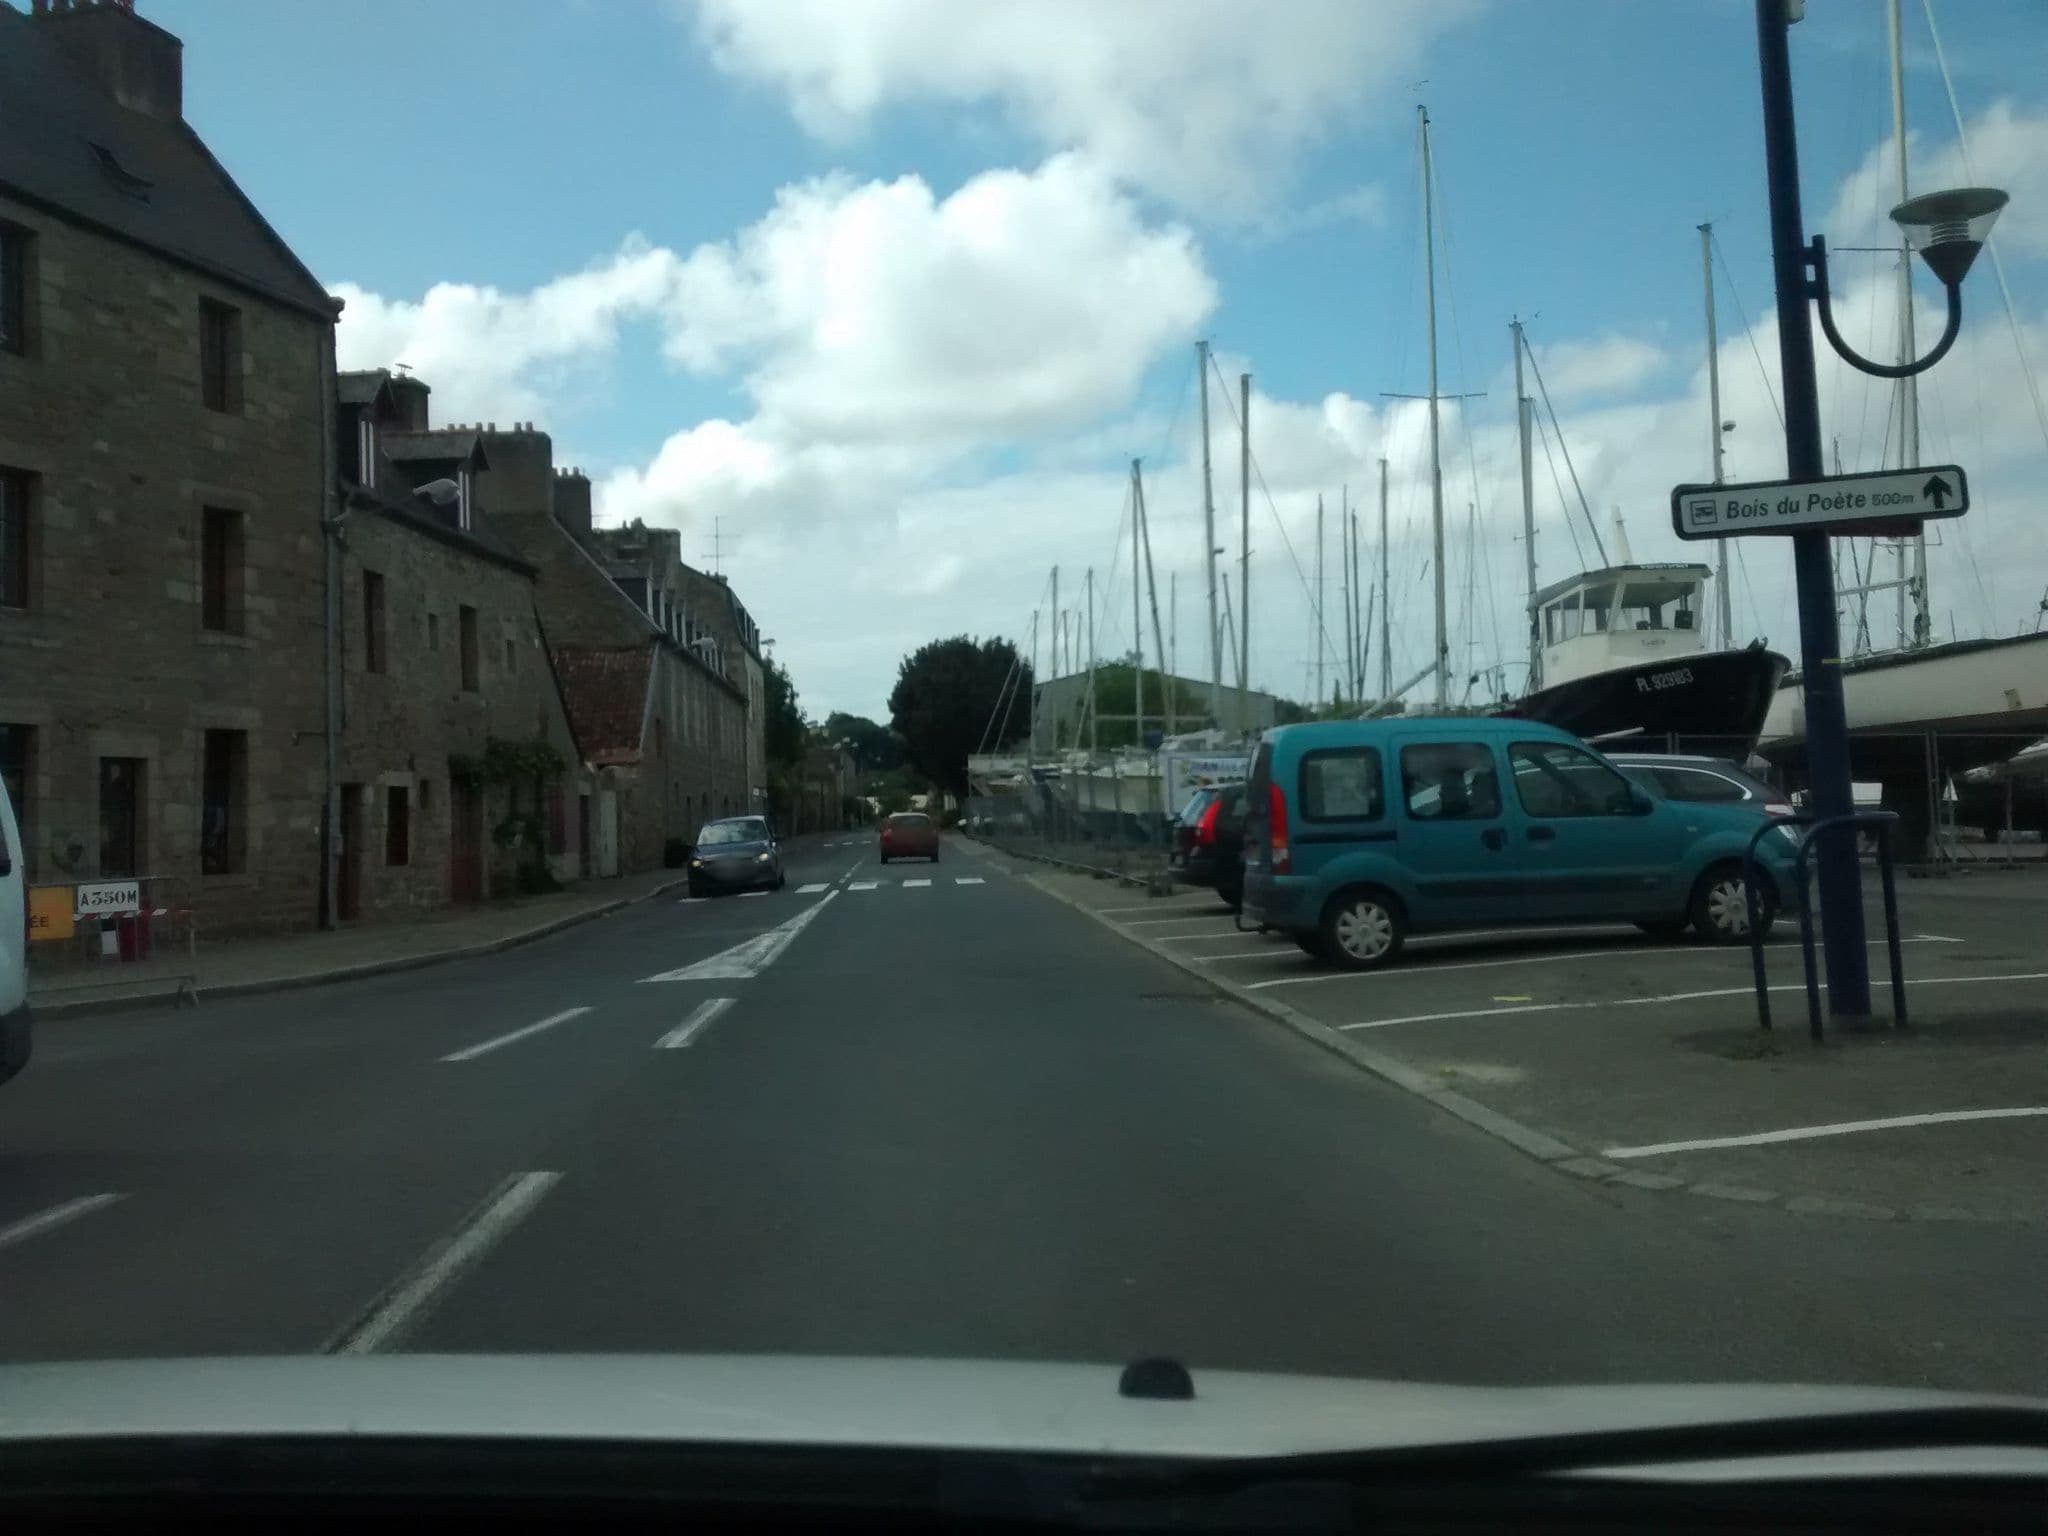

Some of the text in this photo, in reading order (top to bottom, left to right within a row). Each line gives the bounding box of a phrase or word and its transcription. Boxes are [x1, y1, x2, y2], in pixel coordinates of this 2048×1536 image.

[1725, 492, 1914, 520] Bois du Poète 500m
